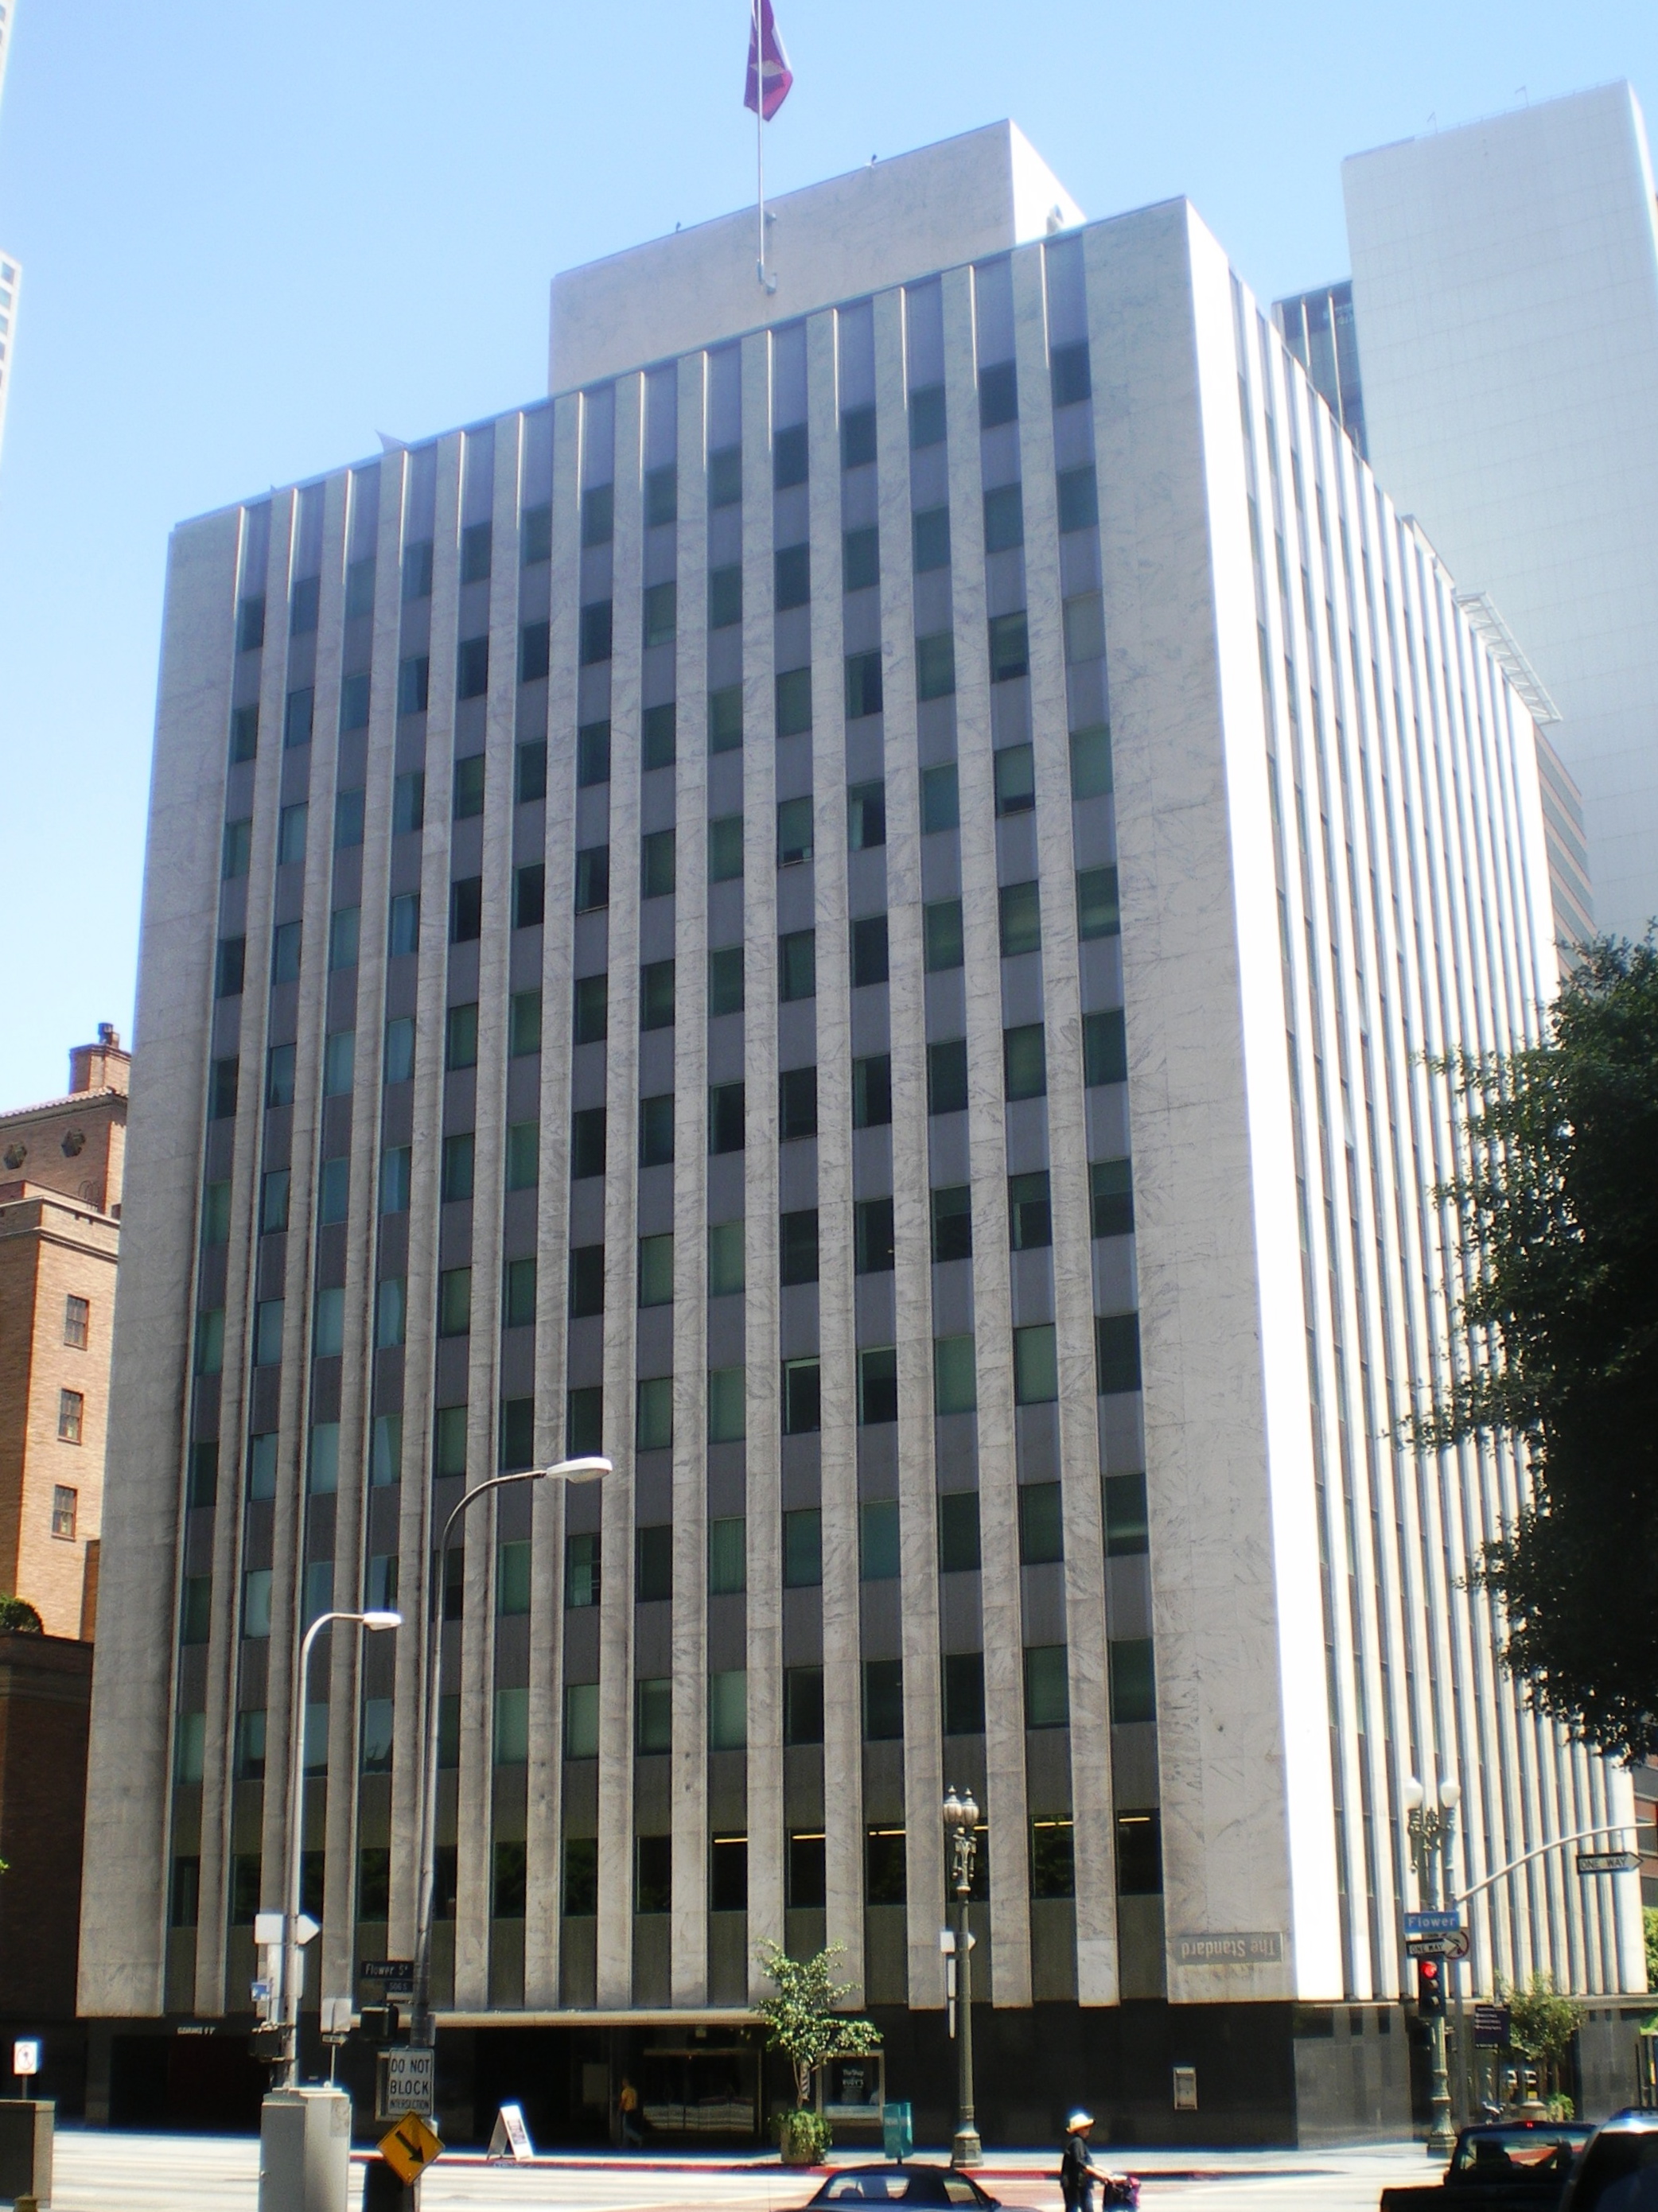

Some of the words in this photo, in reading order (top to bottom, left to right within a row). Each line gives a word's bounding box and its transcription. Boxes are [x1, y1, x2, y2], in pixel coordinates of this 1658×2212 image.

[1580, 1859, 1599, 1869] ONE
[1606, 1856, 1627, 1867] WAY
[1407, 1916, 1455, 1927] Flower
[1181, 1940, 1246, 1958] Standard
[1250, 1939, 1275, 1956] The
[366, 1963, 395, 1976] Flower
[391, 2058, 405, 2074] DO
[410, 2058, 430, 2074] NOT
[390, 2079, 429, 2095] BLOCK
